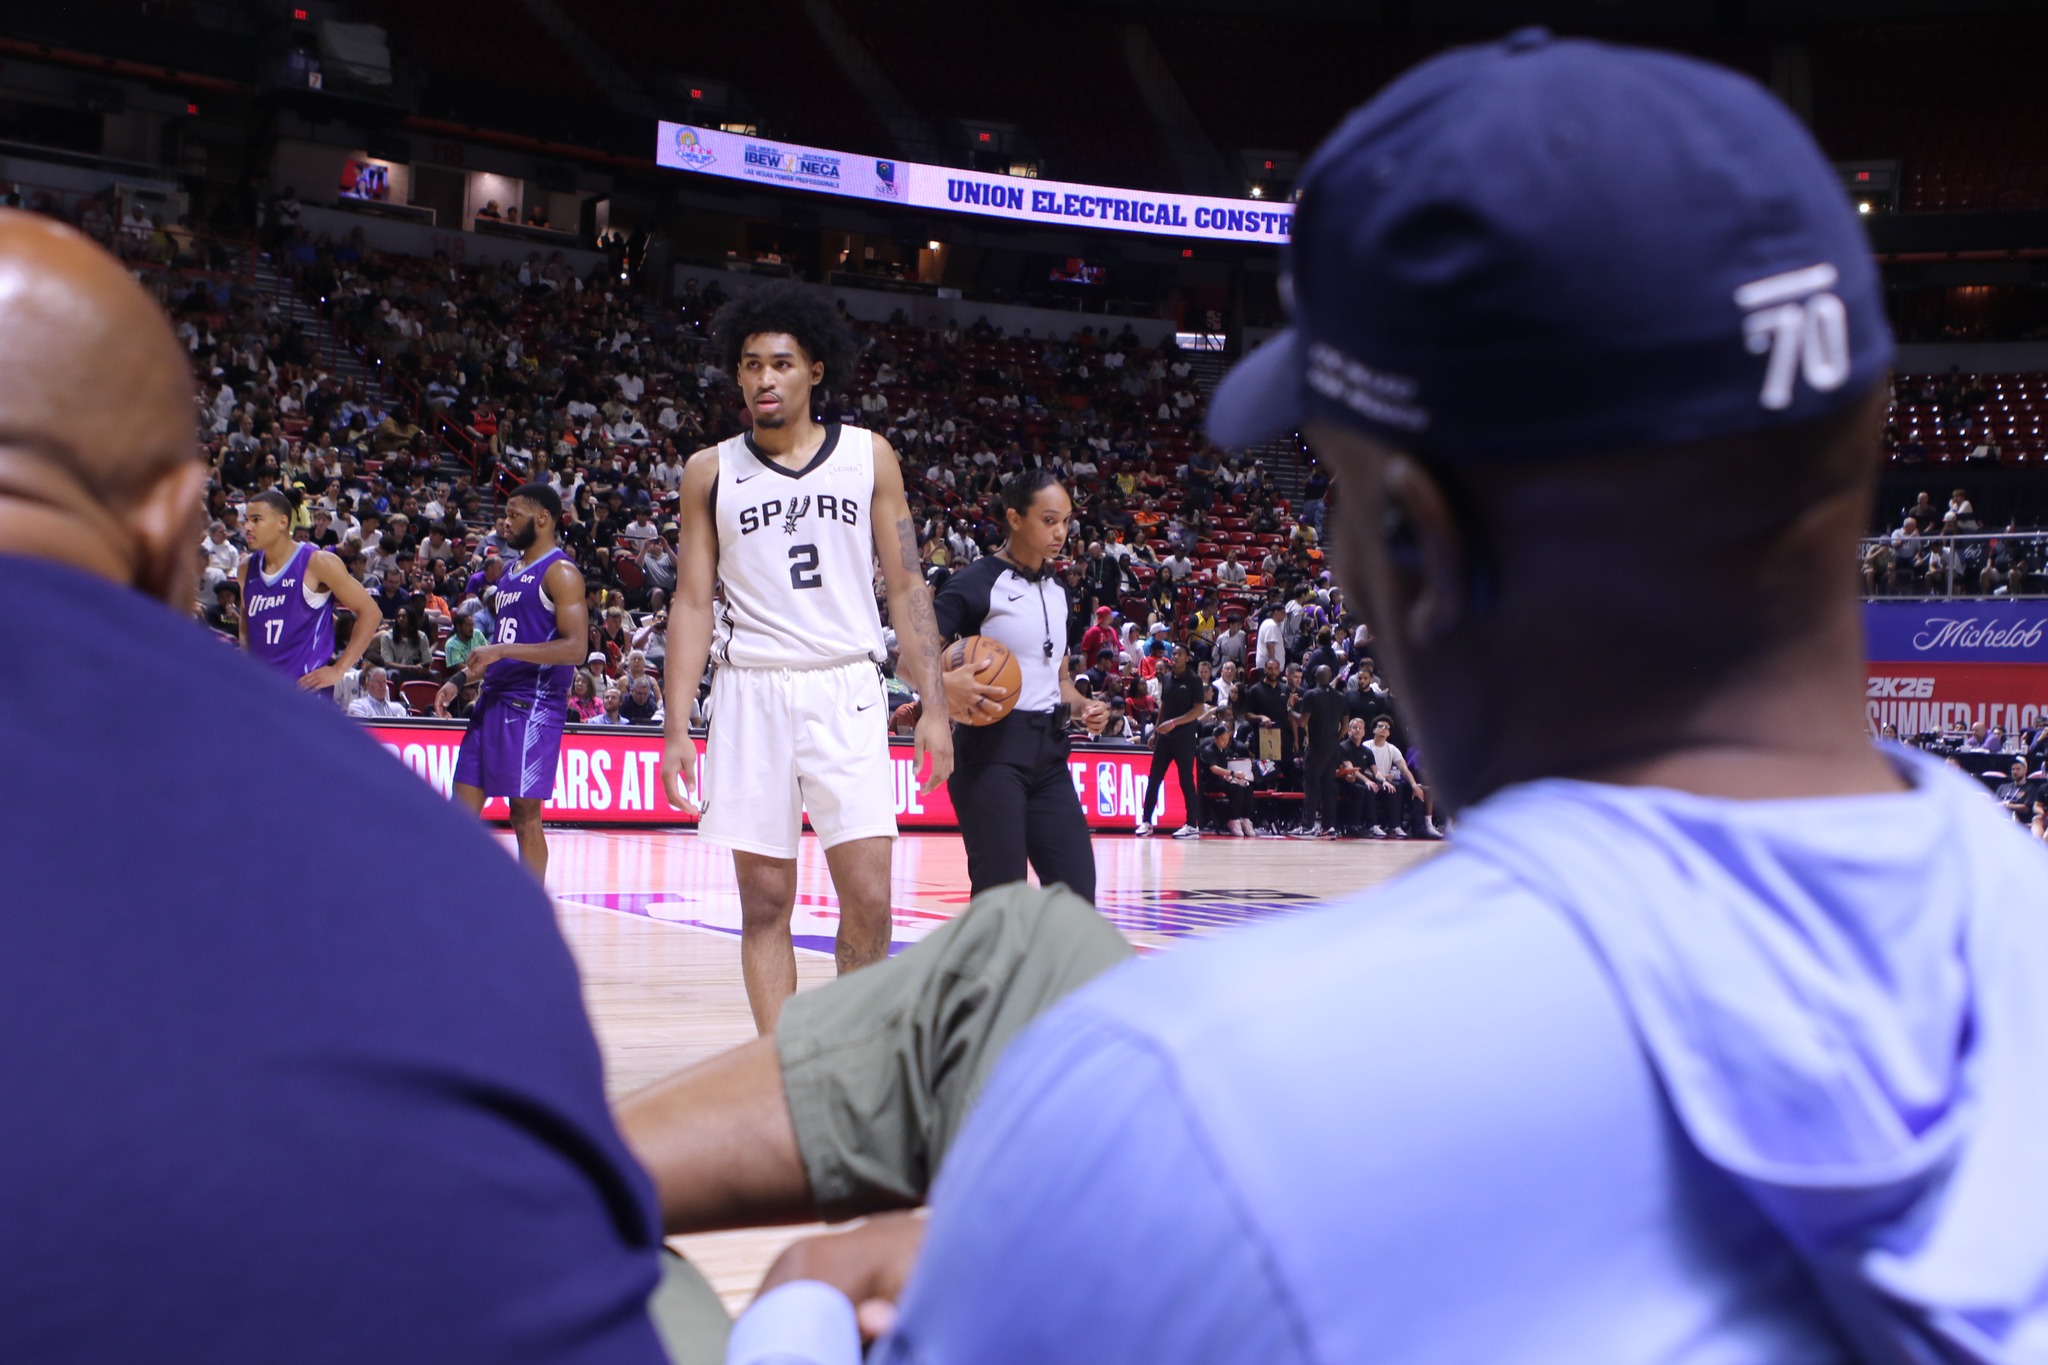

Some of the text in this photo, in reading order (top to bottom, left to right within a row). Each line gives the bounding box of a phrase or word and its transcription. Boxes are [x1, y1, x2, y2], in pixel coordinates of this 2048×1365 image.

[745, 151, 840, 177] IBEW NECA
[948, 179, 1024, 210] UNION
[1032, 190, 1187, 227] ELECTRICAL
[1742, 292, 1851, 411] 70
[740, 494, 858, 536] SPURS
[788, 543, 822, 590] 2
[281, 578, 296, 588] LVT
[248, 594, 286, 617] UTAH
[494, 590, 522, 614] UTAH
[264, 619, 284, 645] 17
[497, 616, 518, 644] 16
[1913, 618, 2048, 651] Michelob
[1866, 677, 1935, 698] 2K26
[619, 751, 660, 811] AT
